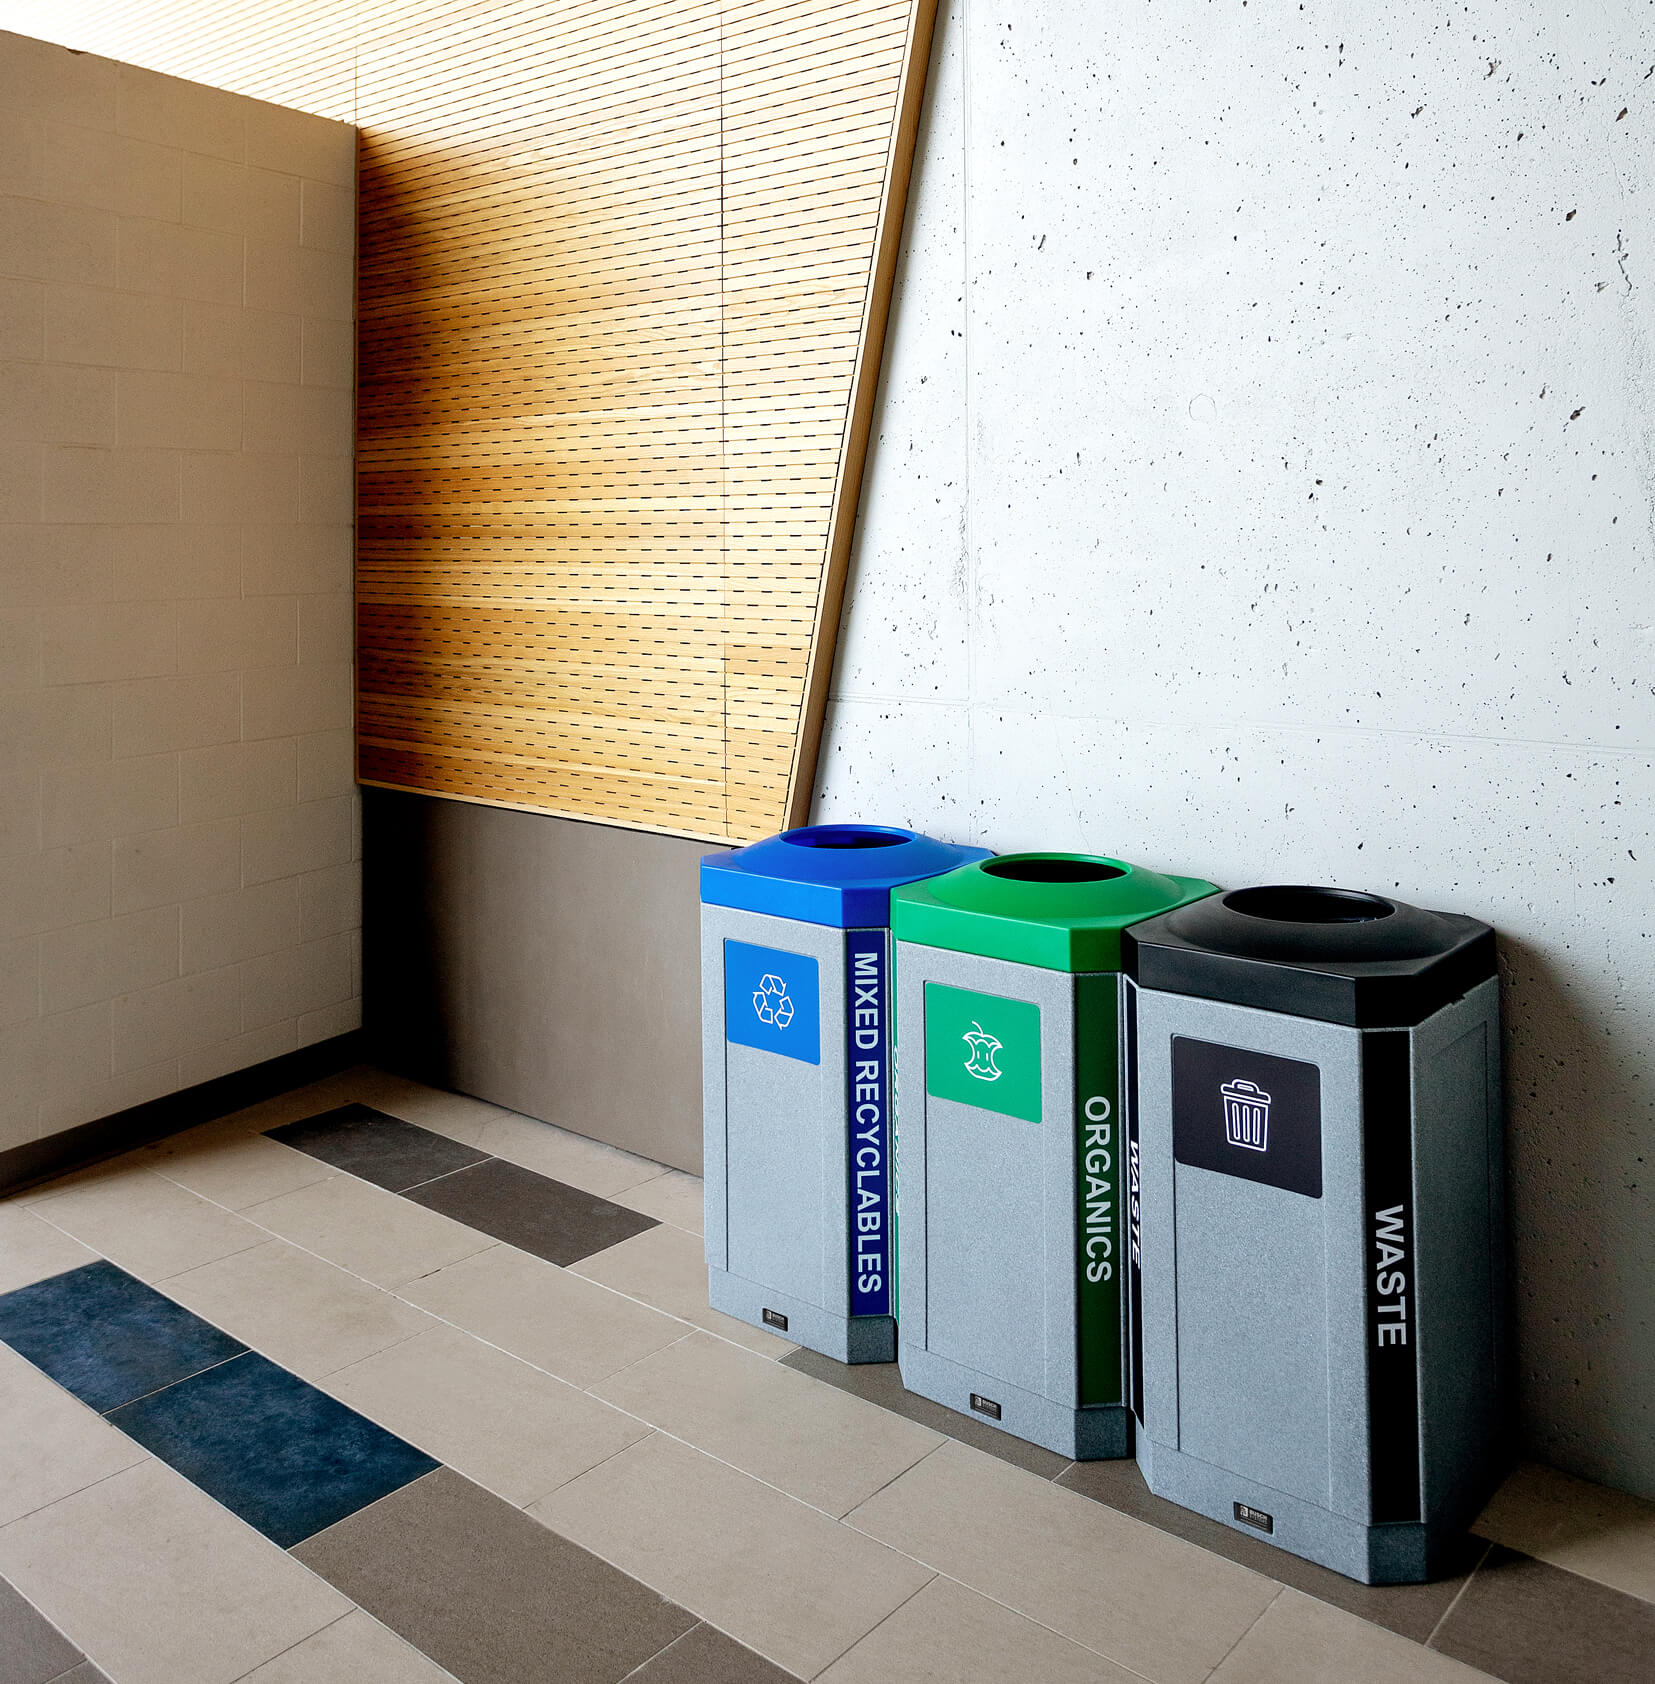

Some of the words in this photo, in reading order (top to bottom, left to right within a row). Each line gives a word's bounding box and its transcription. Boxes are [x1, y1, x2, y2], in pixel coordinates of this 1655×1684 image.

[854, 952, 879, 1049] MIXED
[855, 1060, 882, 1294] RECYCLABLES
[1084, 1095, 1112, 1283] ORGANICS
[1130, 1140, 1141, 1269] WASTE
[1375, 1204, 1407, 1347] WASTE
